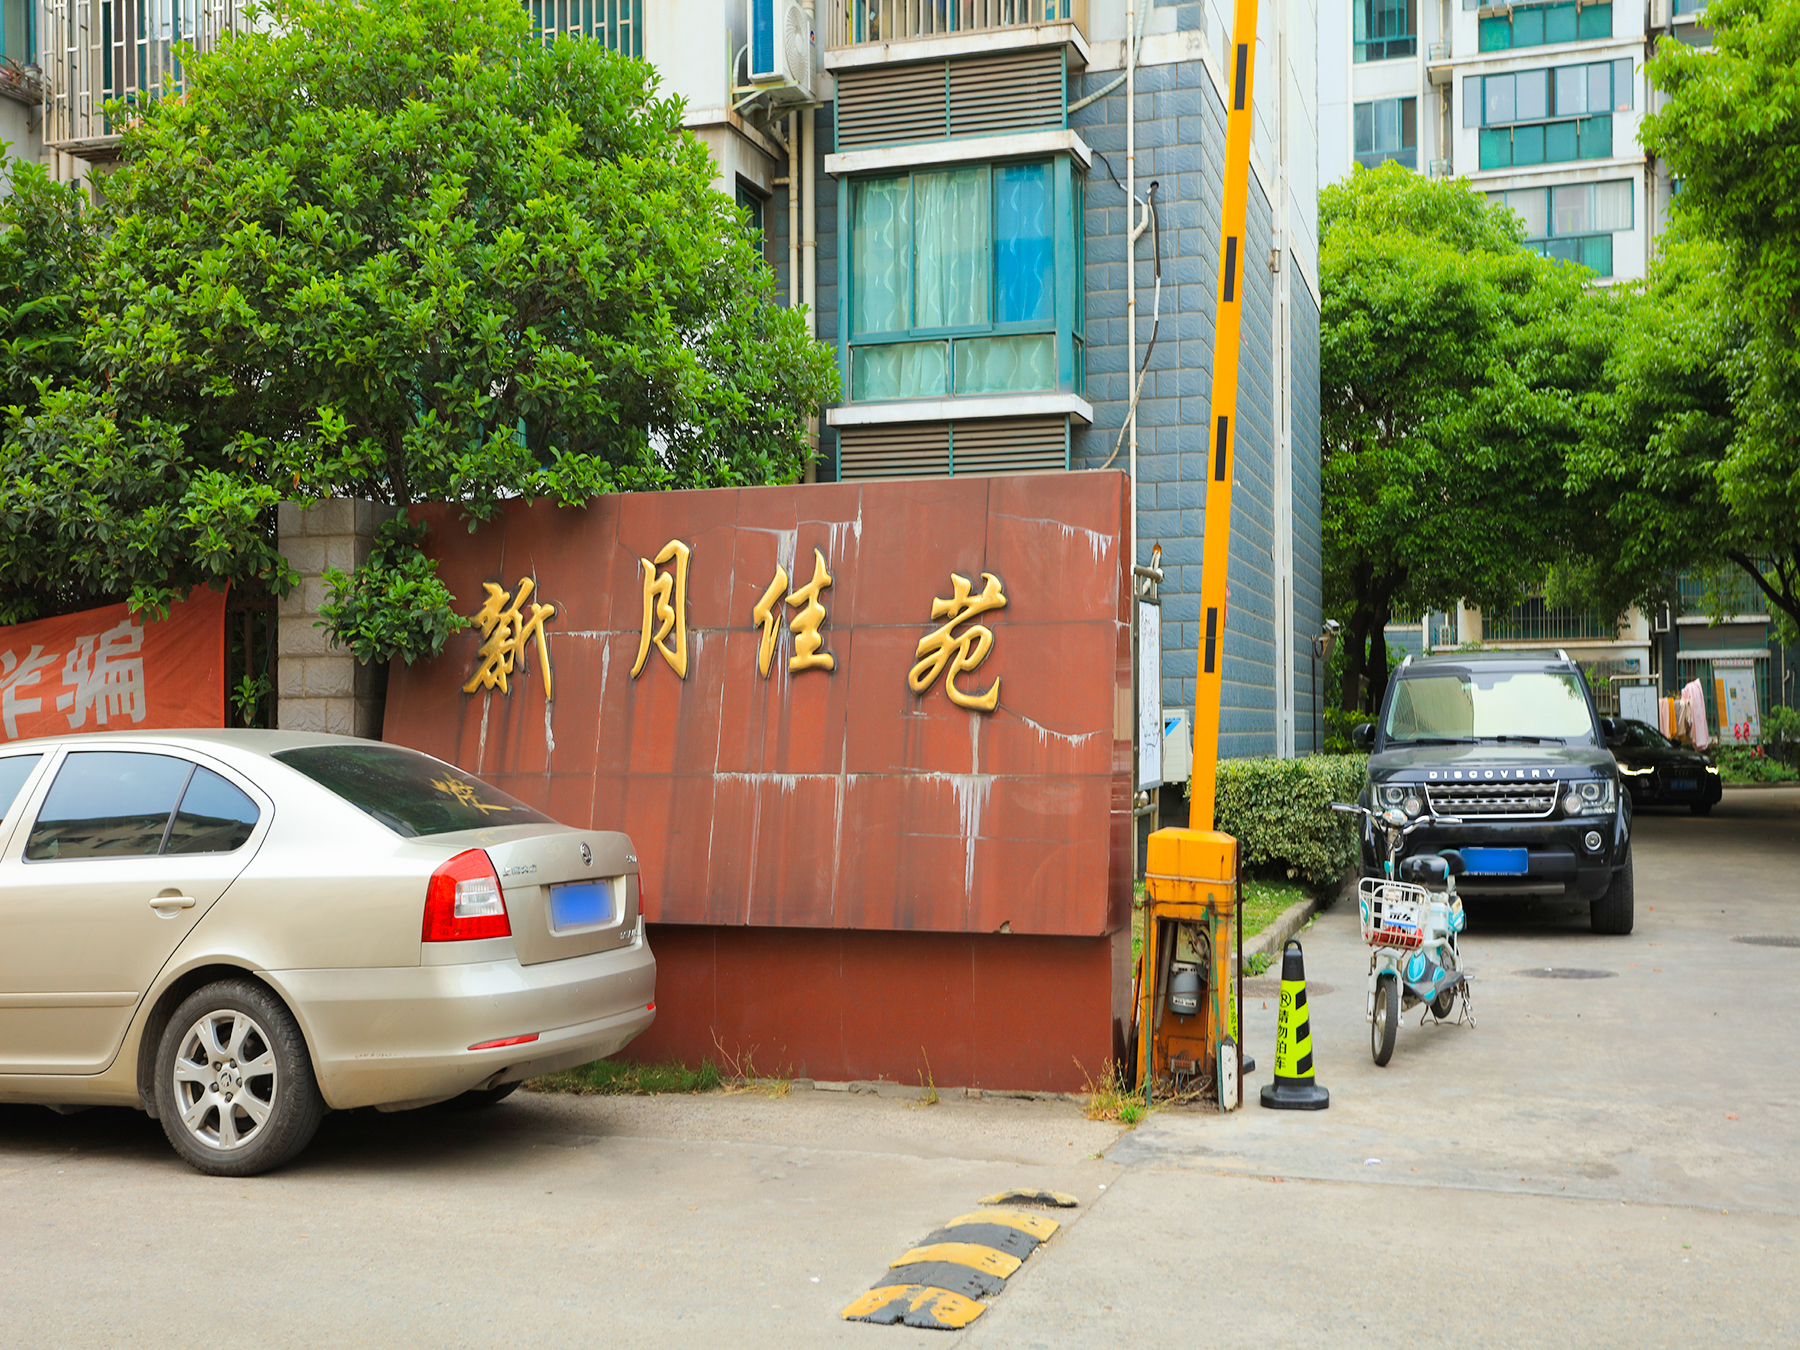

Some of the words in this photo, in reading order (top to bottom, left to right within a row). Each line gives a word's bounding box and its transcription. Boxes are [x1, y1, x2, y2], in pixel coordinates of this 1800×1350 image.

[462, 539, 1007, 712] 新月佳苑
[0, 619, 147, 739] 诈骗
[1428, 768, 1556, 780] DISCOVERY
[1275, 1009, 1290, 1070] 请勿泊车
